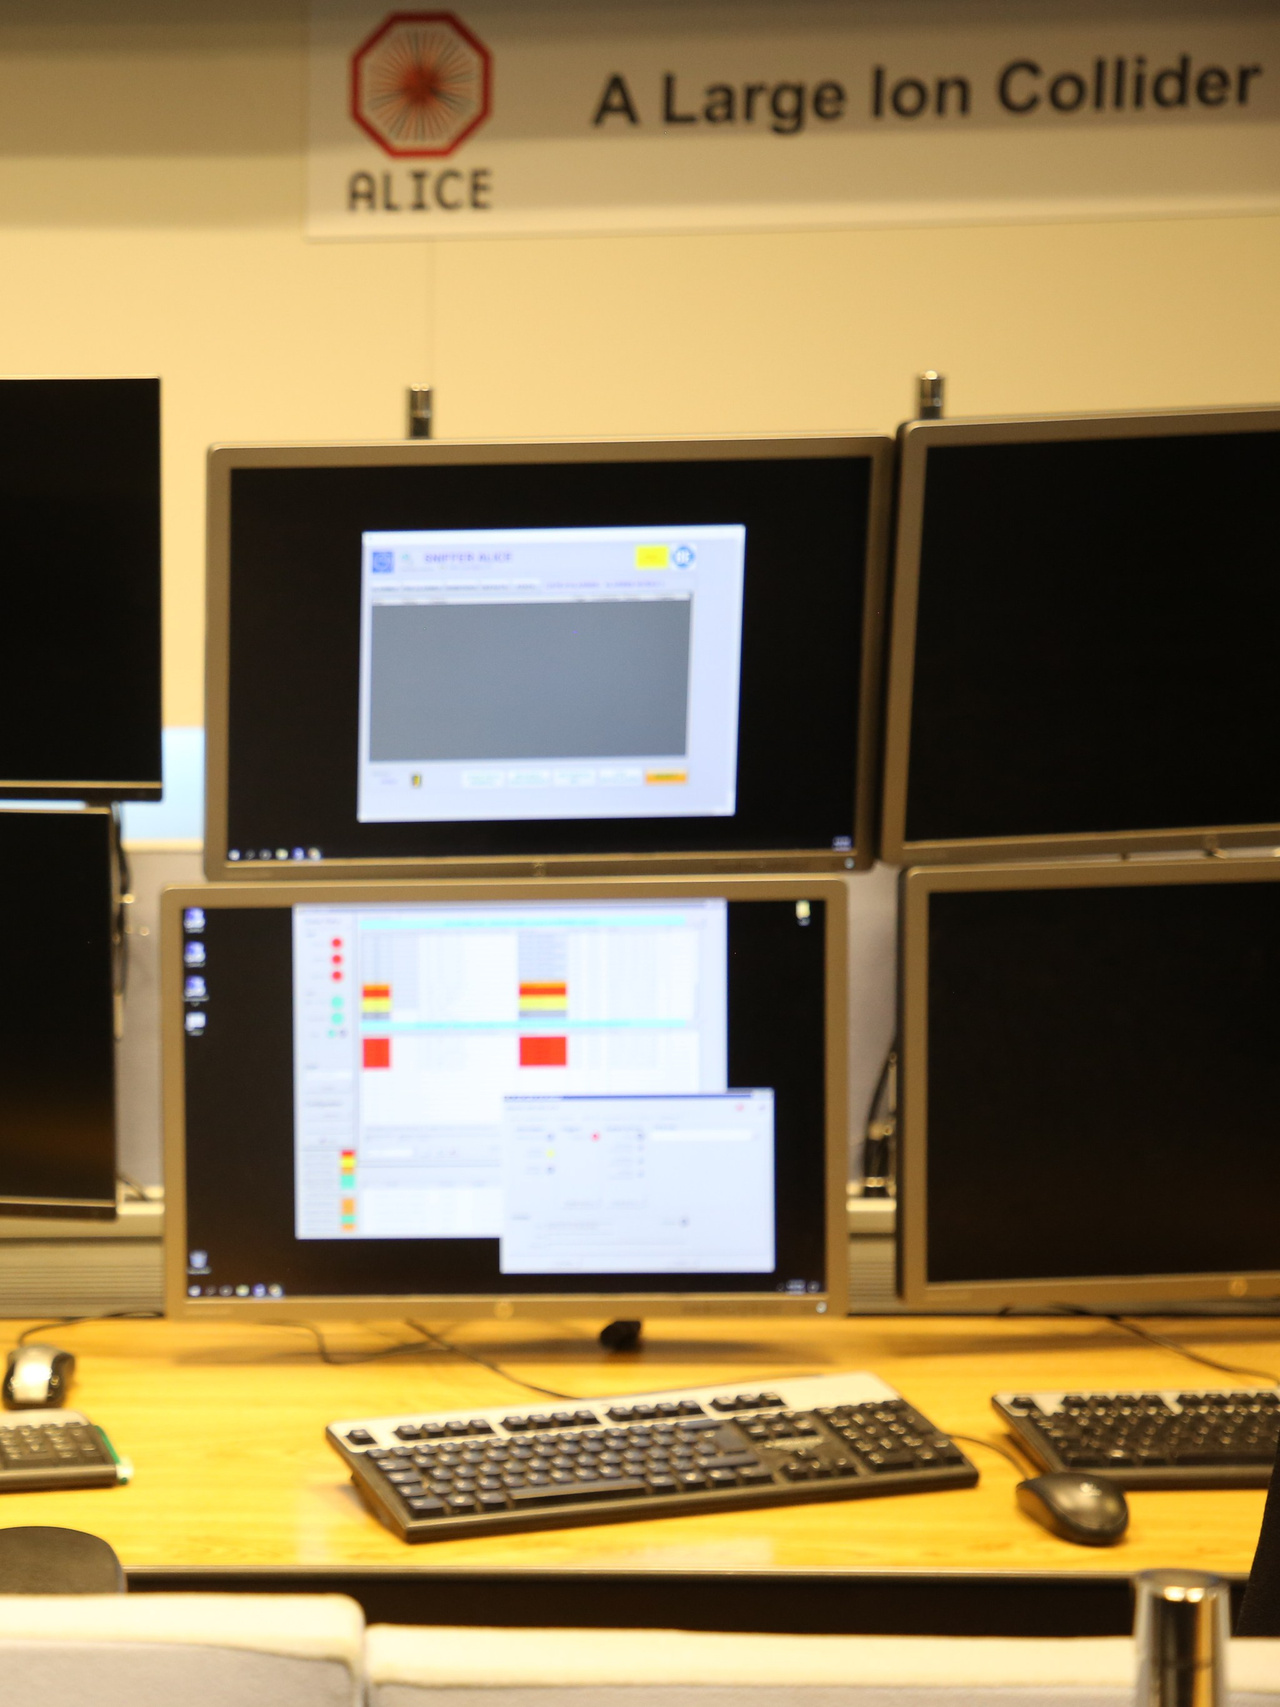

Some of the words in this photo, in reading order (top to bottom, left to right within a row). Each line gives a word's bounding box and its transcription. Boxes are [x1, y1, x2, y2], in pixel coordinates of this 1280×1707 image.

[592, 73, 640, 128] A
[662, 72, 848, 135] Large
[872, 65, 972, 120] Ion
[998, 54, 1262, 114] Collider
[349, 170, 493, 212] ALICE
